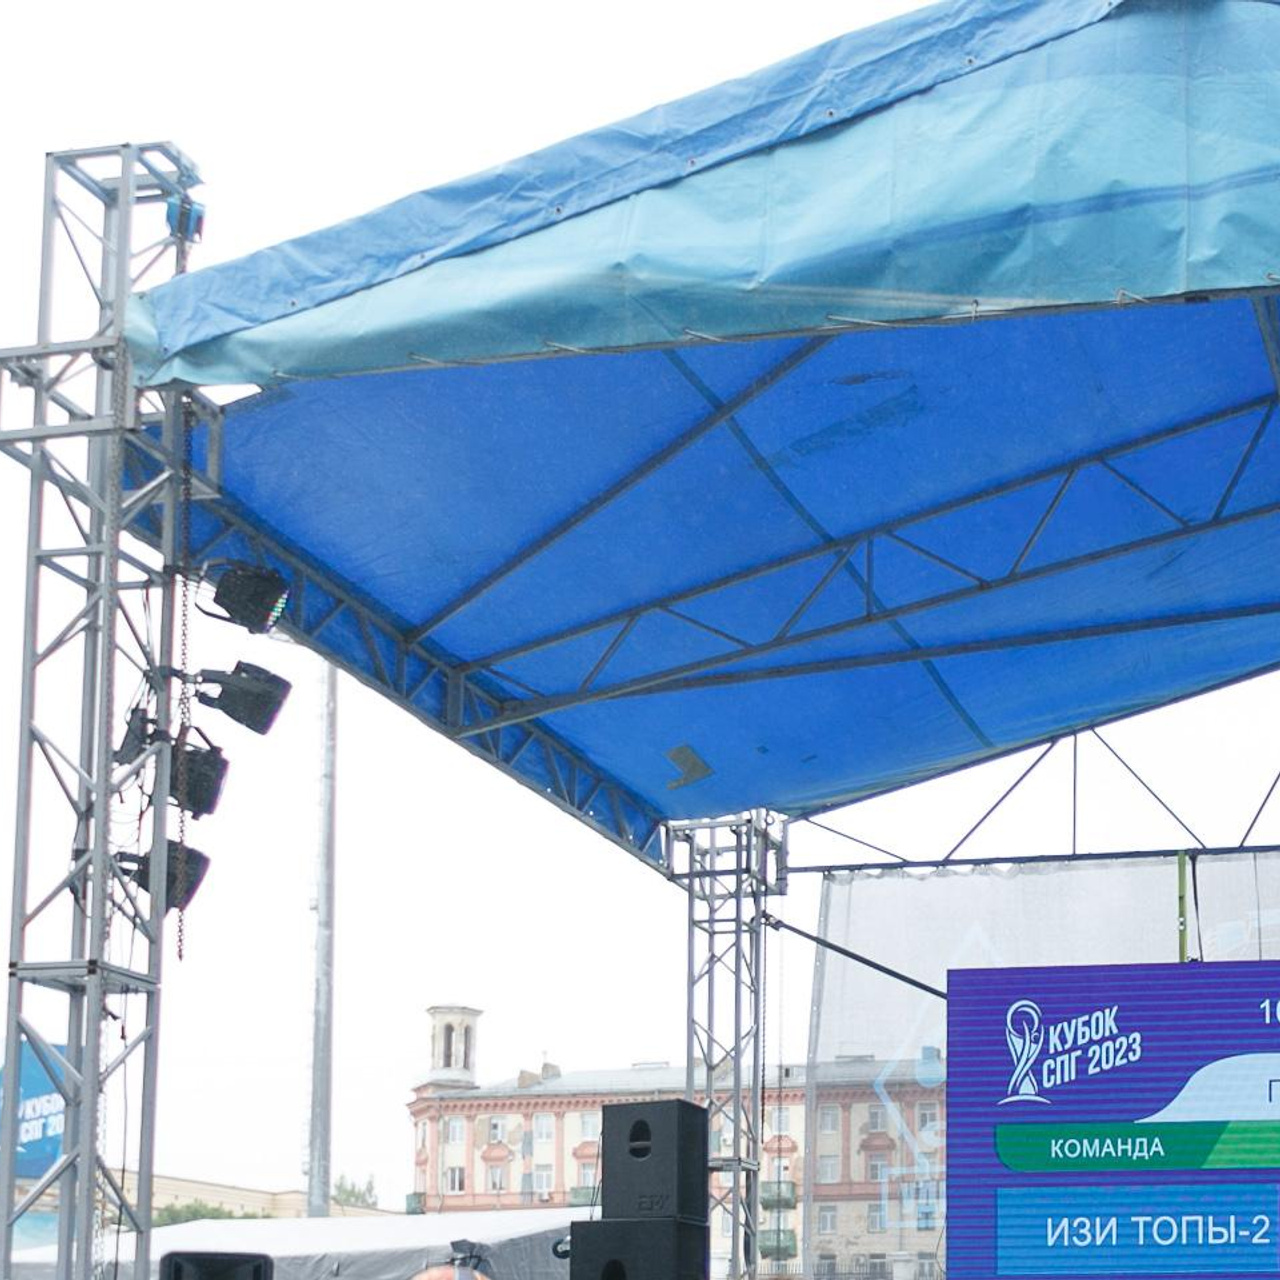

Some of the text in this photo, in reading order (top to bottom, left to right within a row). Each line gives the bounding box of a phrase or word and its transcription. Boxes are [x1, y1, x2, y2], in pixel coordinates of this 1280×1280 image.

[1048, 1004, 1119, 1055] КУБОК
[1042, 1031, 1142, 1088] СПГ 2023
[1050, 1137, 1165, 1160] КОМАНДА
[1046, 1214, 1271, 1247] ИЗИ ТОПЫ-2
